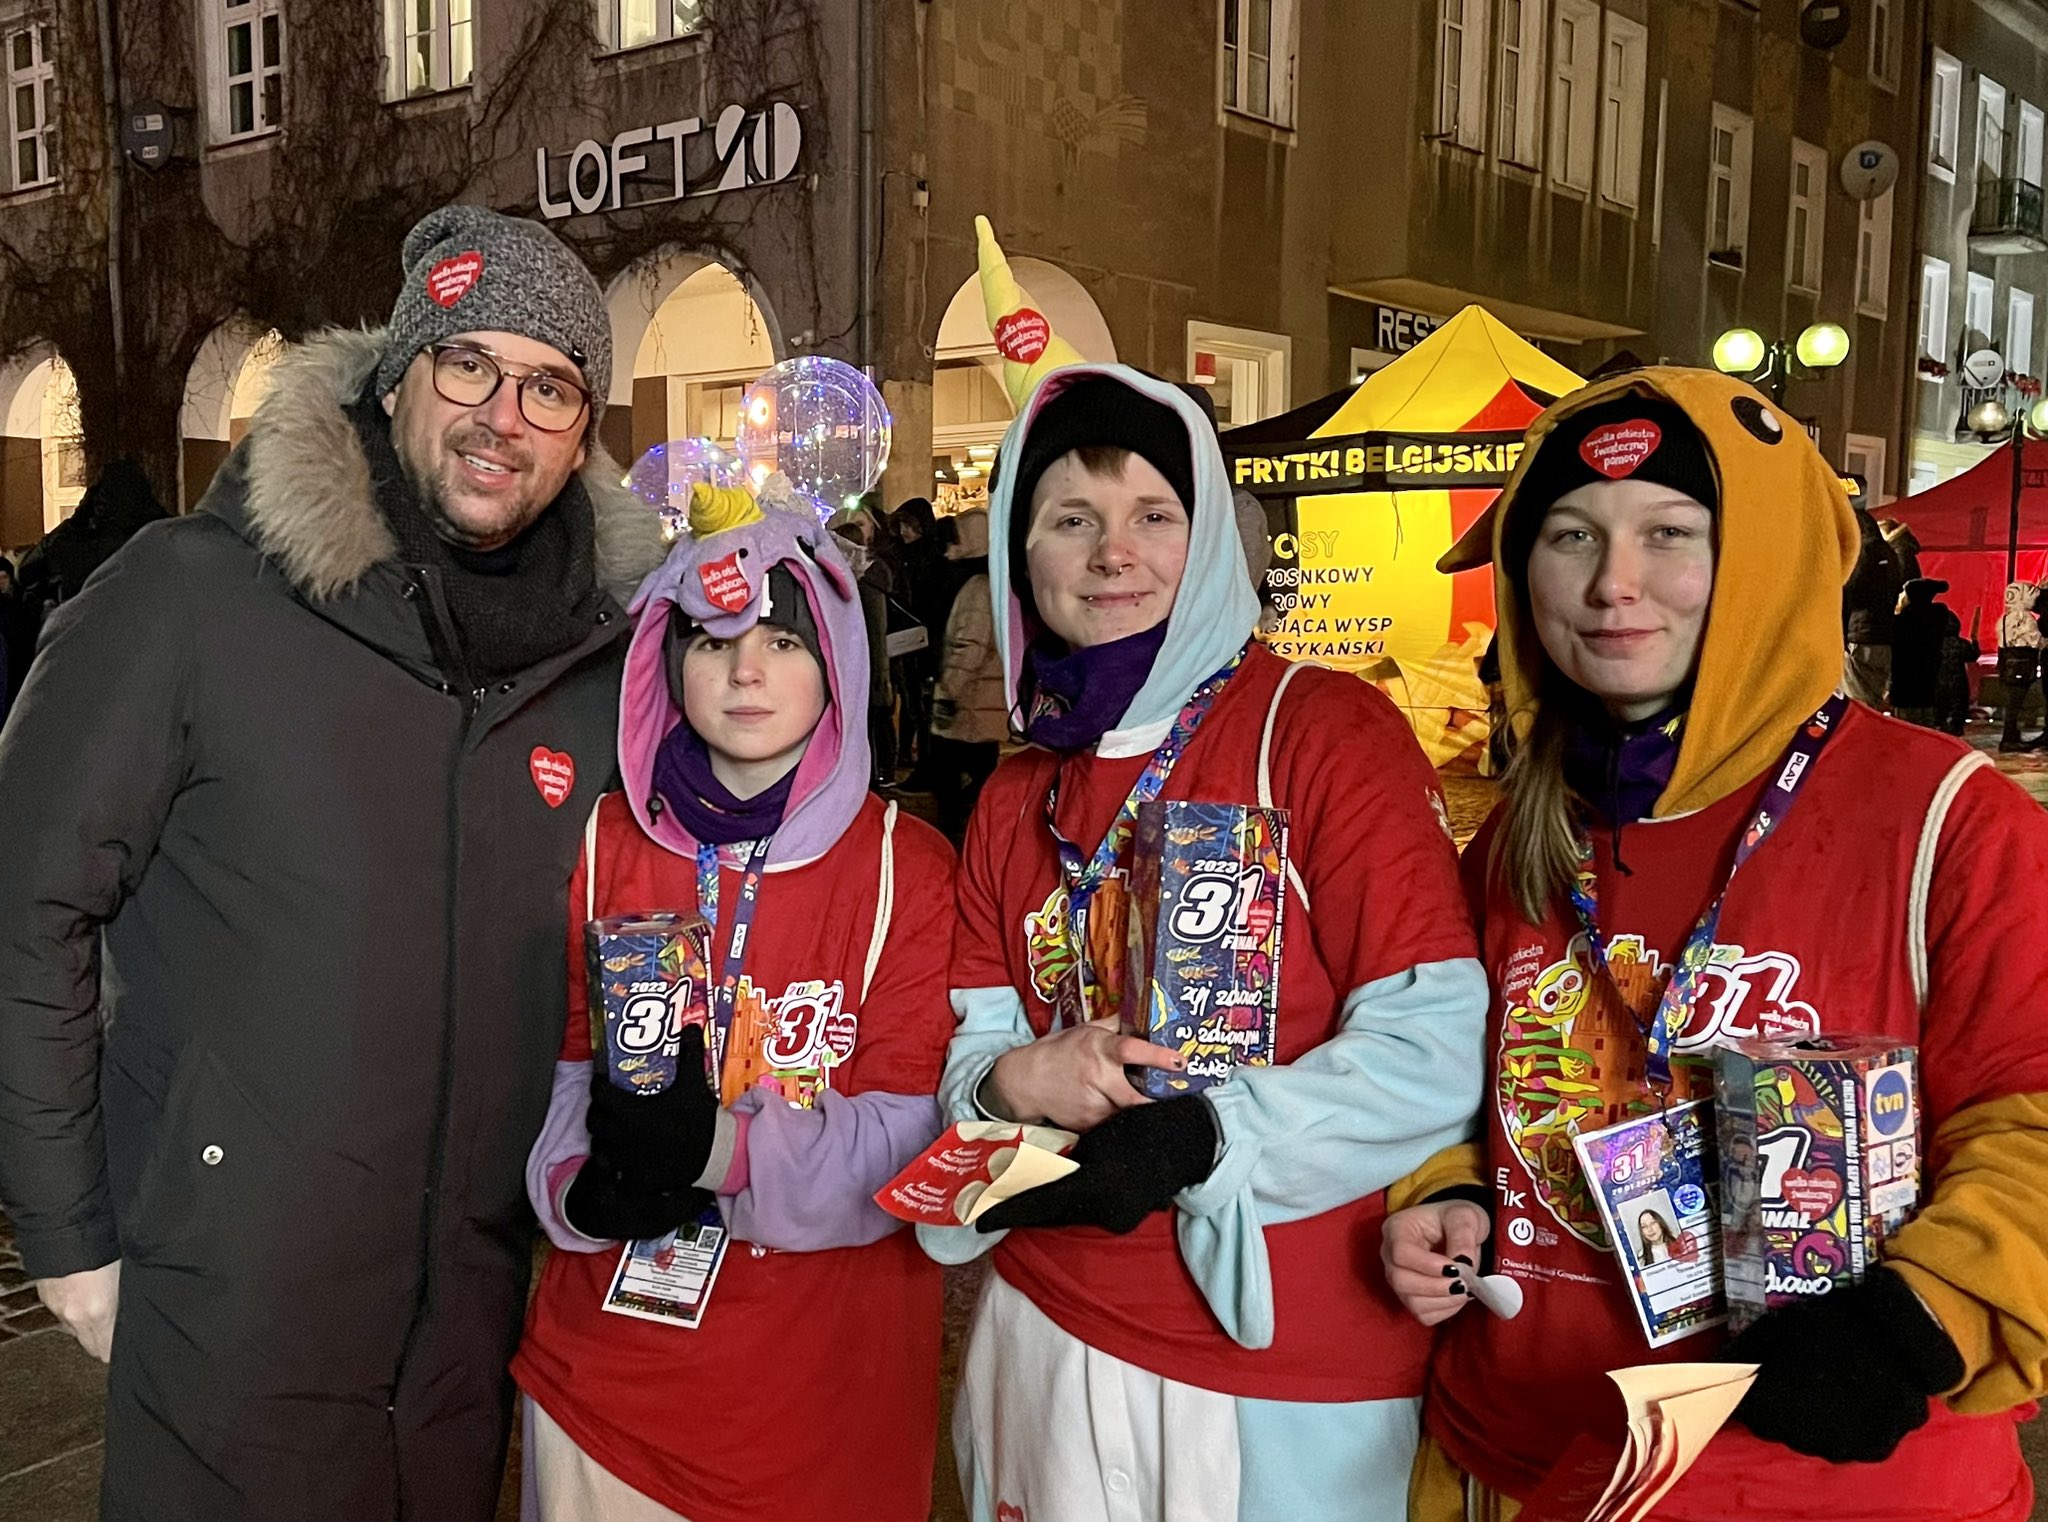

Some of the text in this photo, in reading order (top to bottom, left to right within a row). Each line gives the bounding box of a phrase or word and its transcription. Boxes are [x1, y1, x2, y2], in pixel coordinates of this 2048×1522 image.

[537, 102, 801, 219] LOFT 20
[1378, 307, 1440, 351] RES
[1268, 530, 1339, 560] OSY
[1271, 593, 1331, 611] ROWY
[1271, 617, 1393, 636] SIĄCA WYSP
[1268, 638, 1384, 656] KSYKAŃSKI
[1783, 754, 1804, 788] PLAY
[1193, 859, 1239, 873] 2023
[1173, 868, 1262, 940] 31
[629, 982, 668, 993] 2023
[620, 980, 690, 1051] 31
[1176, 1025, 1192, 1038] w
[1187, 1055, 1244, 1079] świe
[1875, 1091, 1904, 1116] tvn
[1612, 1141, 1647, 1183] 31
[1766, 1262, 1832, 1295] drowo
